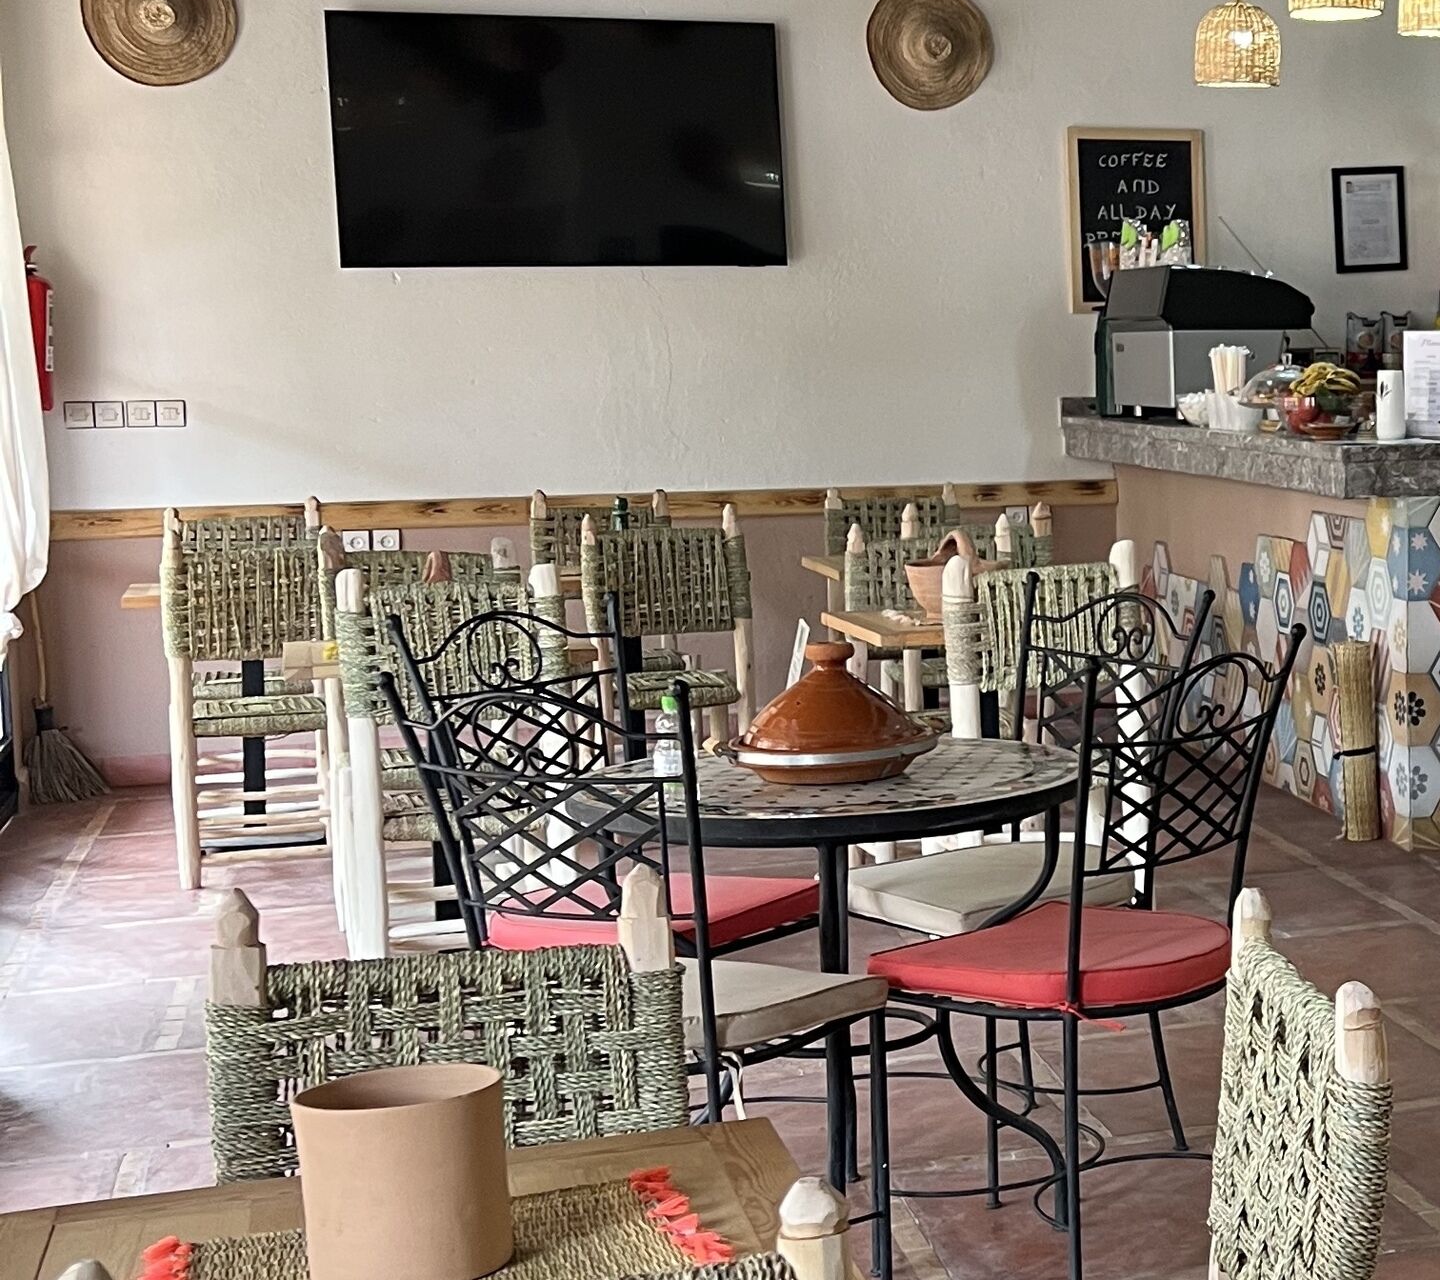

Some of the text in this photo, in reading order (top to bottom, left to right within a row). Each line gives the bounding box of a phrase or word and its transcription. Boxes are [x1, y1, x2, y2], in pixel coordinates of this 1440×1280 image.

[1098, 152, 1168, 167] COFFEE
[1117, 179, 1160, 195] AND
[1097, 204, 1177, 221] ALL DAY
